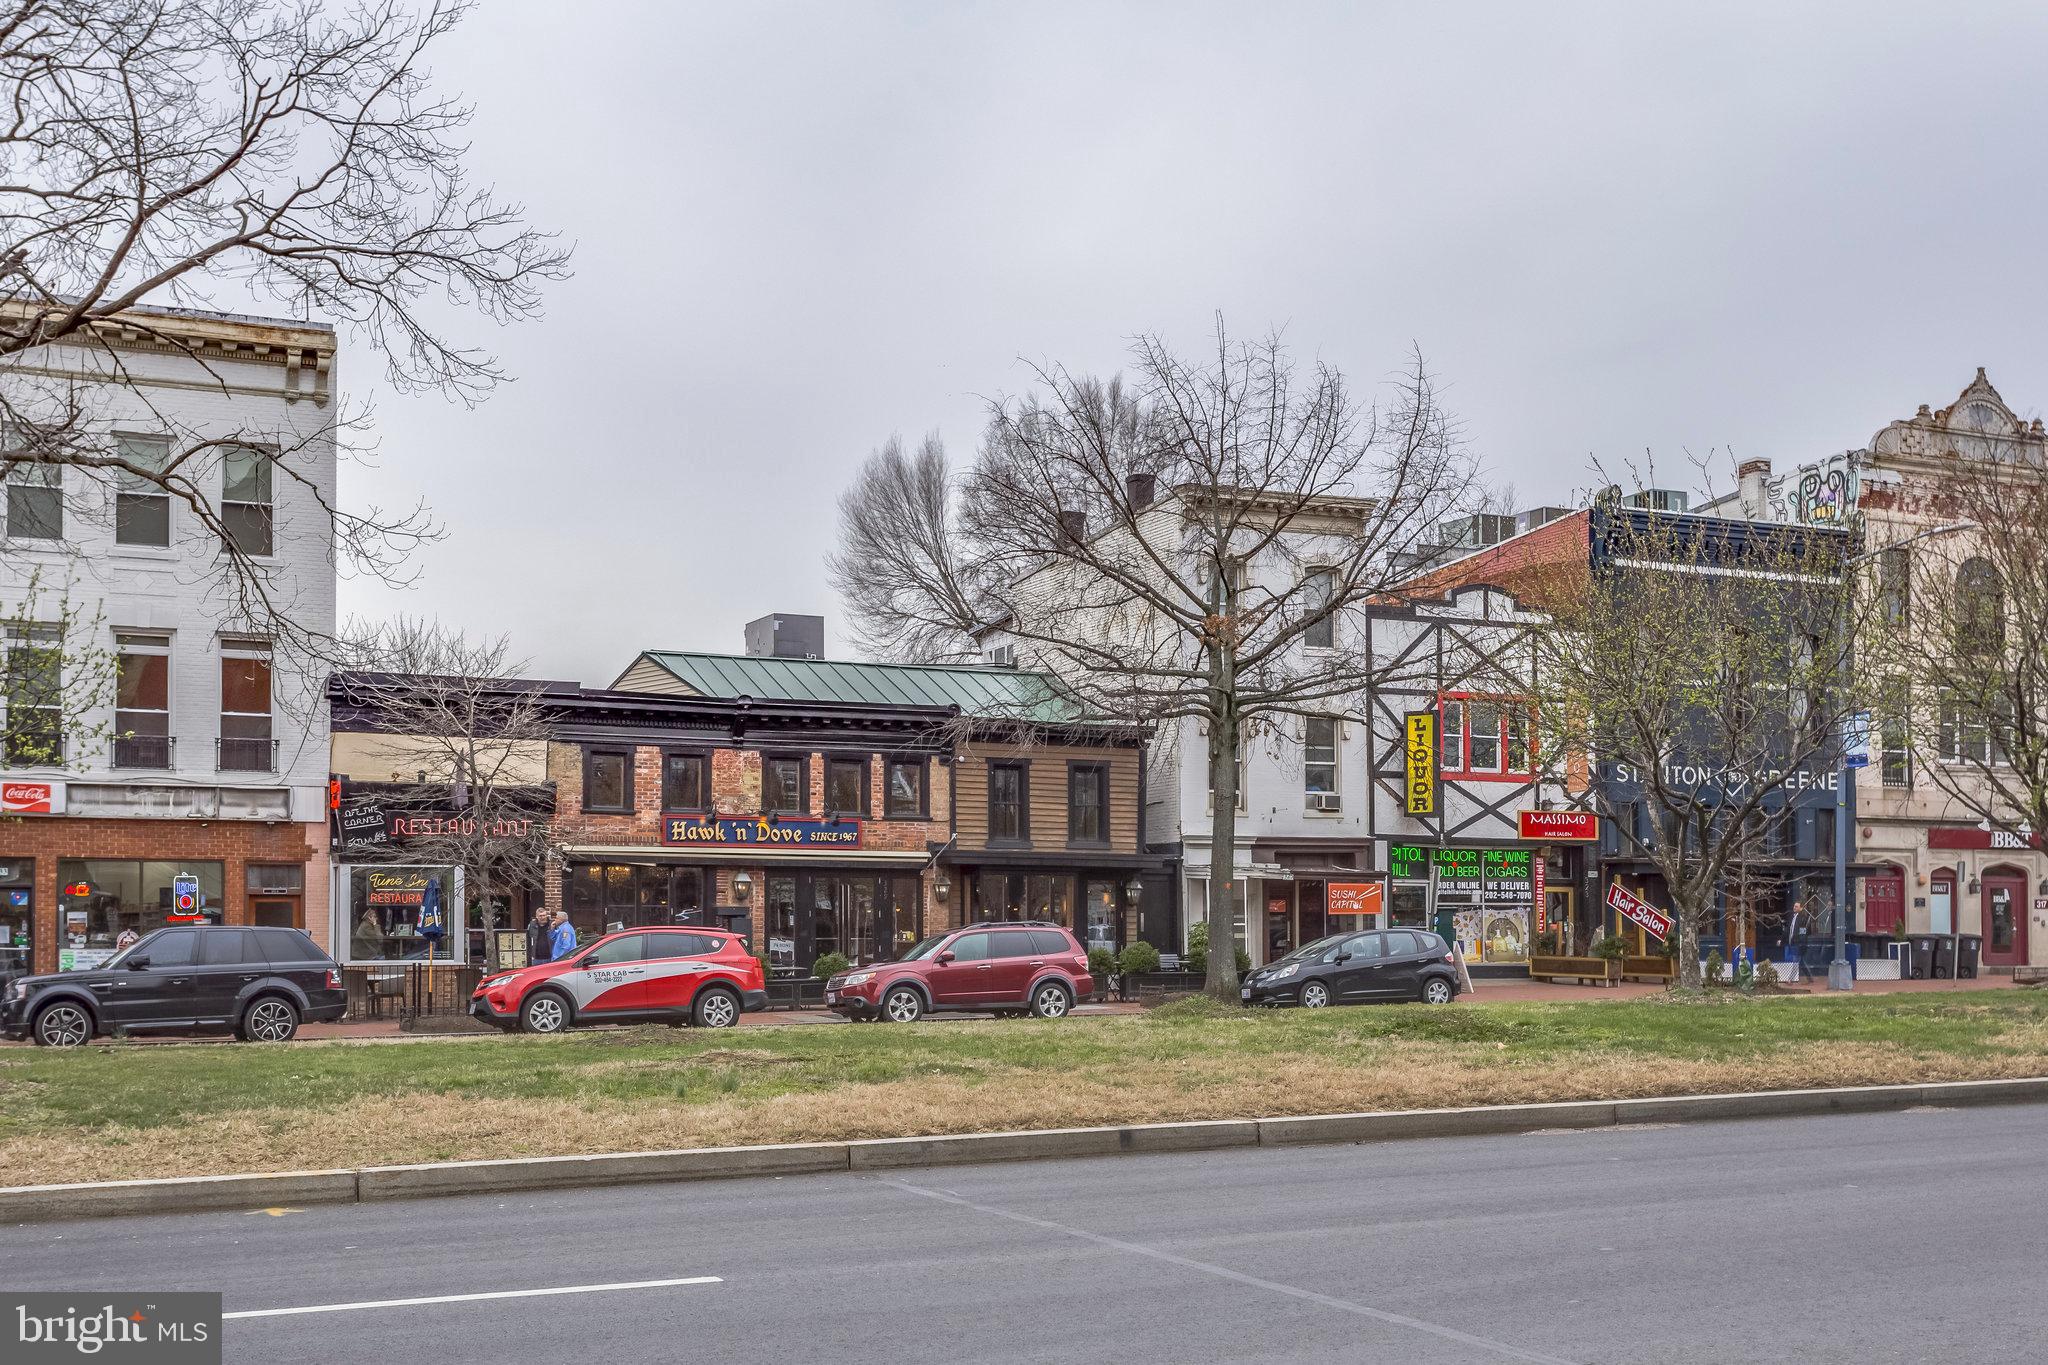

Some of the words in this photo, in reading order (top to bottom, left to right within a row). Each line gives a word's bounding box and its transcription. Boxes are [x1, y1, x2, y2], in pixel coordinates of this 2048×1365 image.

[1413, 718, 1429, 811] LIQUOR
[1530, 813, 1586, 825] MASSIMO
[391, 818, 533, 836] RESTAUANT
[672, 821, 726, 842] Hawk
[756, 821, 802, 843] Dove
[810, 832, 838, 842] SINCE
[839, 833, 858, 842] 1967
[1990, 831, 2033, 849] BB&T
[1392, 847, 1425, 862] PITOL
[1433, 850, 1477, 863] LIQUOR
[1504, 851, 1530, 863] WINE
[1457, 866, 1481, 877] BEER
[1485, 865, 1528, 878] CIGARS
[369, 873, 404, 887] Tune
[404, 873, 429, 887] In
[1457, 881, 1481, 890] ONLINE
[1487, 881, 1499, 890] WE
[1501, 881, 1530, 890] DELIVER
[370, 893, 422, 904] RESTAURA
[1330, 890, 1357, 899] SUSHI
[2036, 900, 2047, 908] 317
[1612, 889, 1635, 912] Hair
[1631, 905, 1665, 935] Salon
